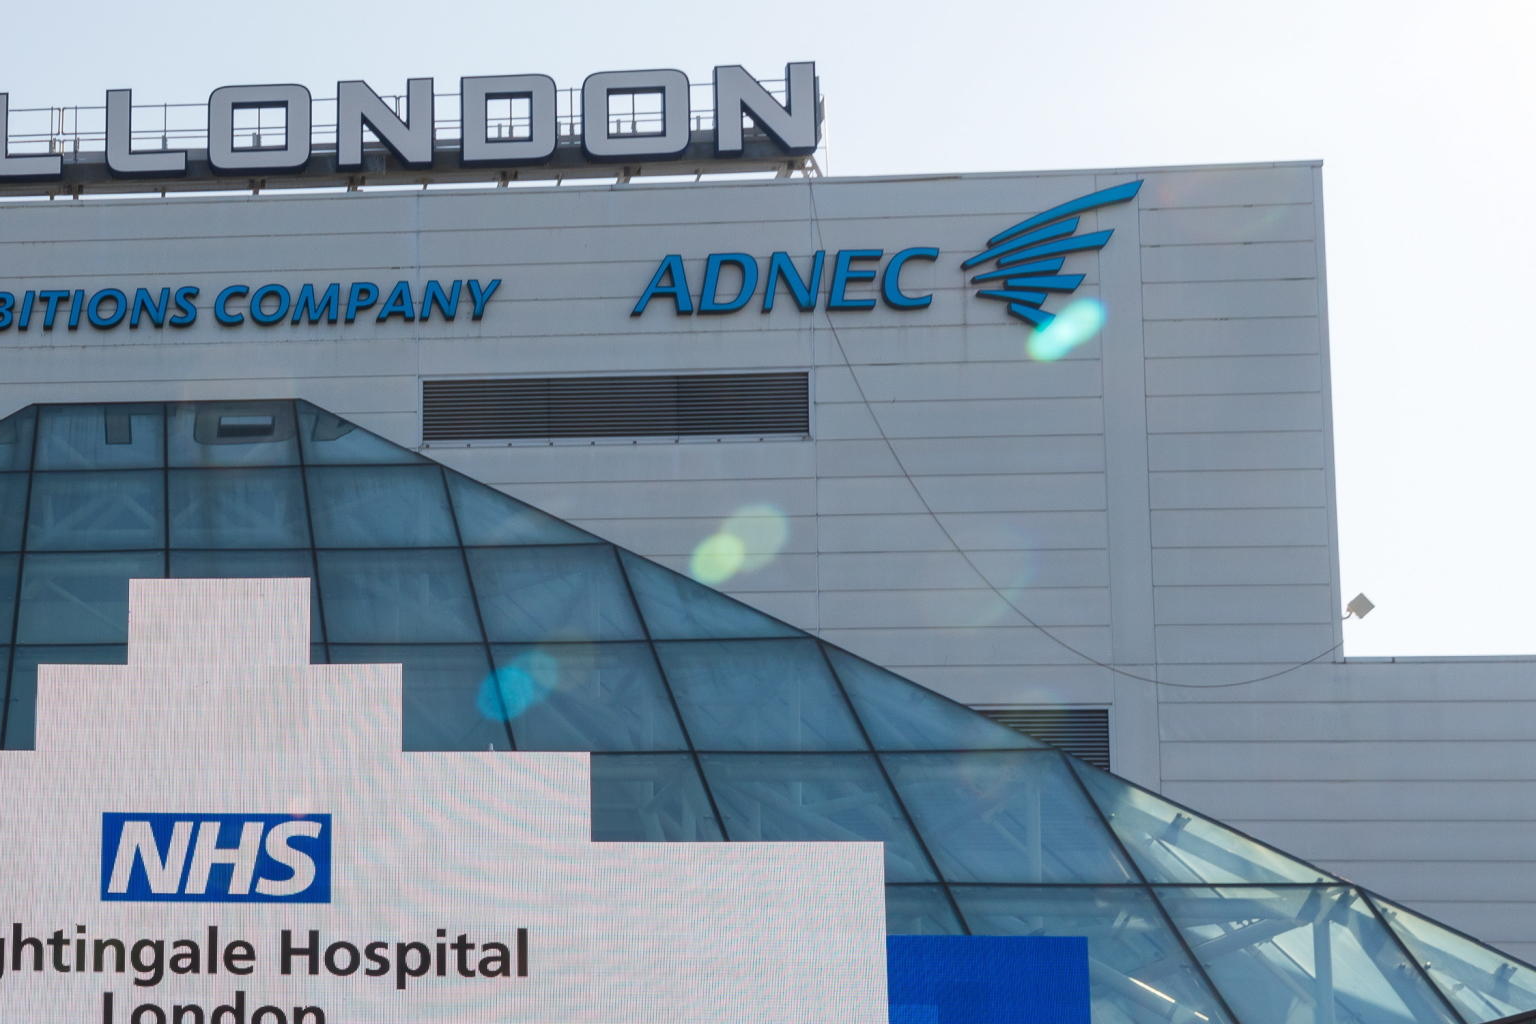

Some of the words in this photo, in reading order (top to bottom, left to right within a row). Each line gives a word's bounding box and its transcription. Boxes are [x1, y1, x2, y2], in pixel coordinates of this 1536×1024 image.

[106, 61, 817, 181] LONDON
[214, 278, 502, 326] COMPANY
[630, 246, 941, 319] ADNEC
[106, 821, 323, 897] NHS
[280, 927, 529, 990] Hospital
